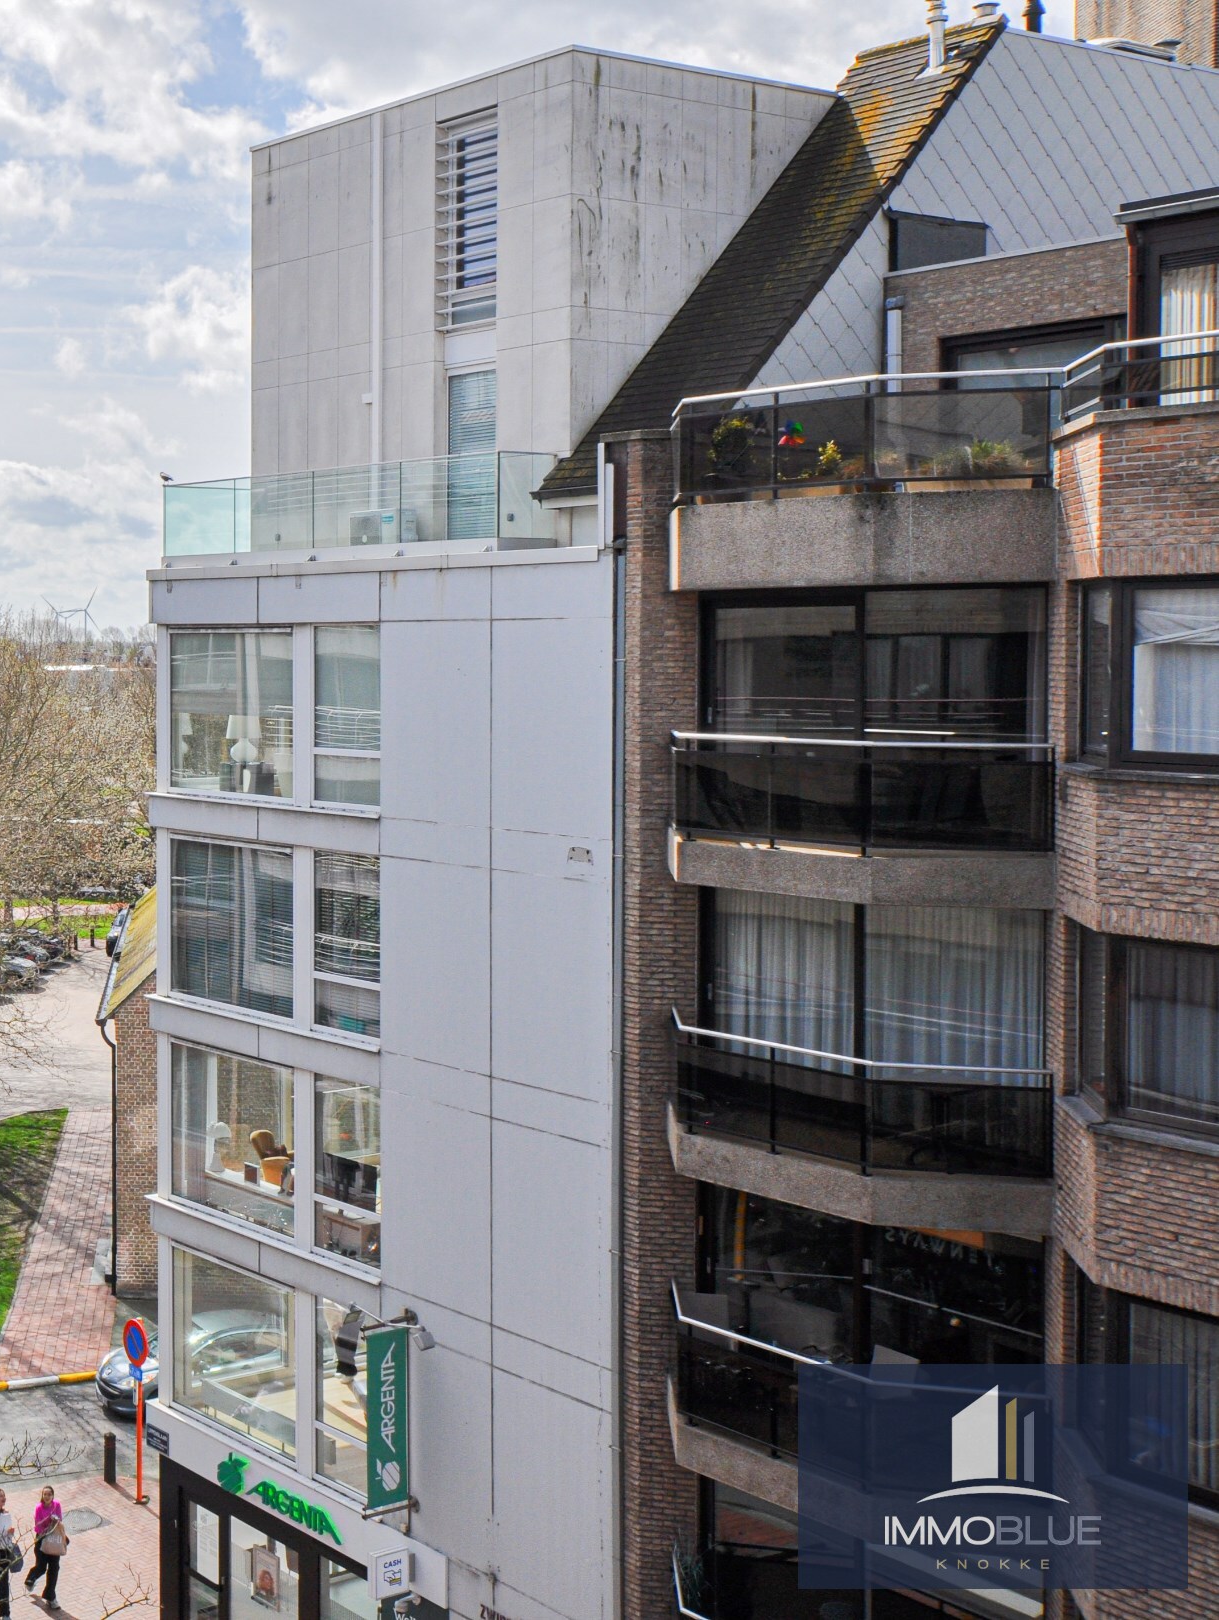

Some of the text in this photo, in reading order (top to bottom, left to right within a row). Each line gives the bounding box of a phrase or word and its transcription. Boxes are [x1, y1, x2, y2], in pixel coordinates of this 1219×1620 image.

[380, 1341, 397, 1453] ARGENTA
[246, 1479, 343, 1546] ARGENTA
[383, 1558, 402, 1569] CASH
